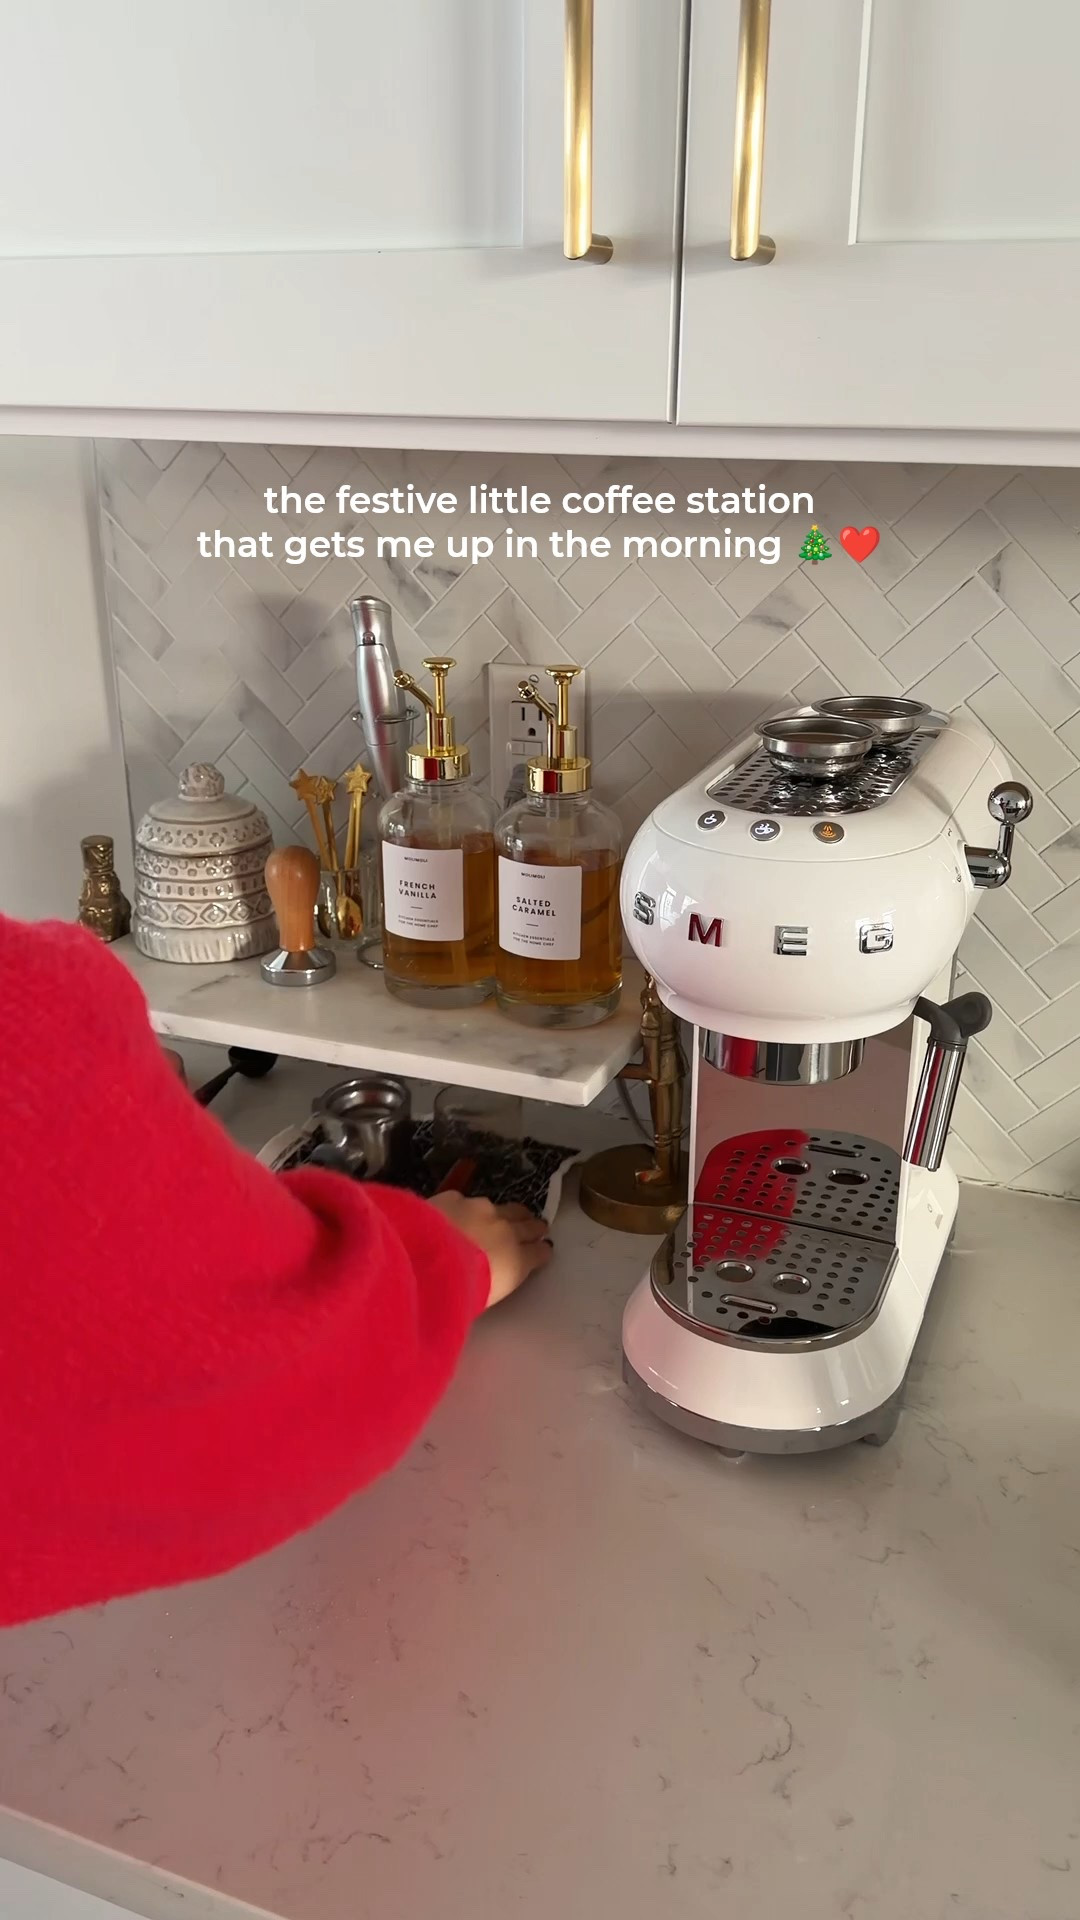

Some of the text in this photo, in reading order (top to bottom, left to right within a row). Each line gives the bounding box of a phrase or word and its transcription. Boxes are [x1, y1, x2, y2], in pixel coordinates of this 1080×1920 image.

[399, 880, 436, 890] FRENCH
[398, 888, 437, 899] VANILLA
[516, 896, 551, 907] SALTED
[512, 904, 557, 917] CARAMEL
[632, 891, 895, 957] SMEG
